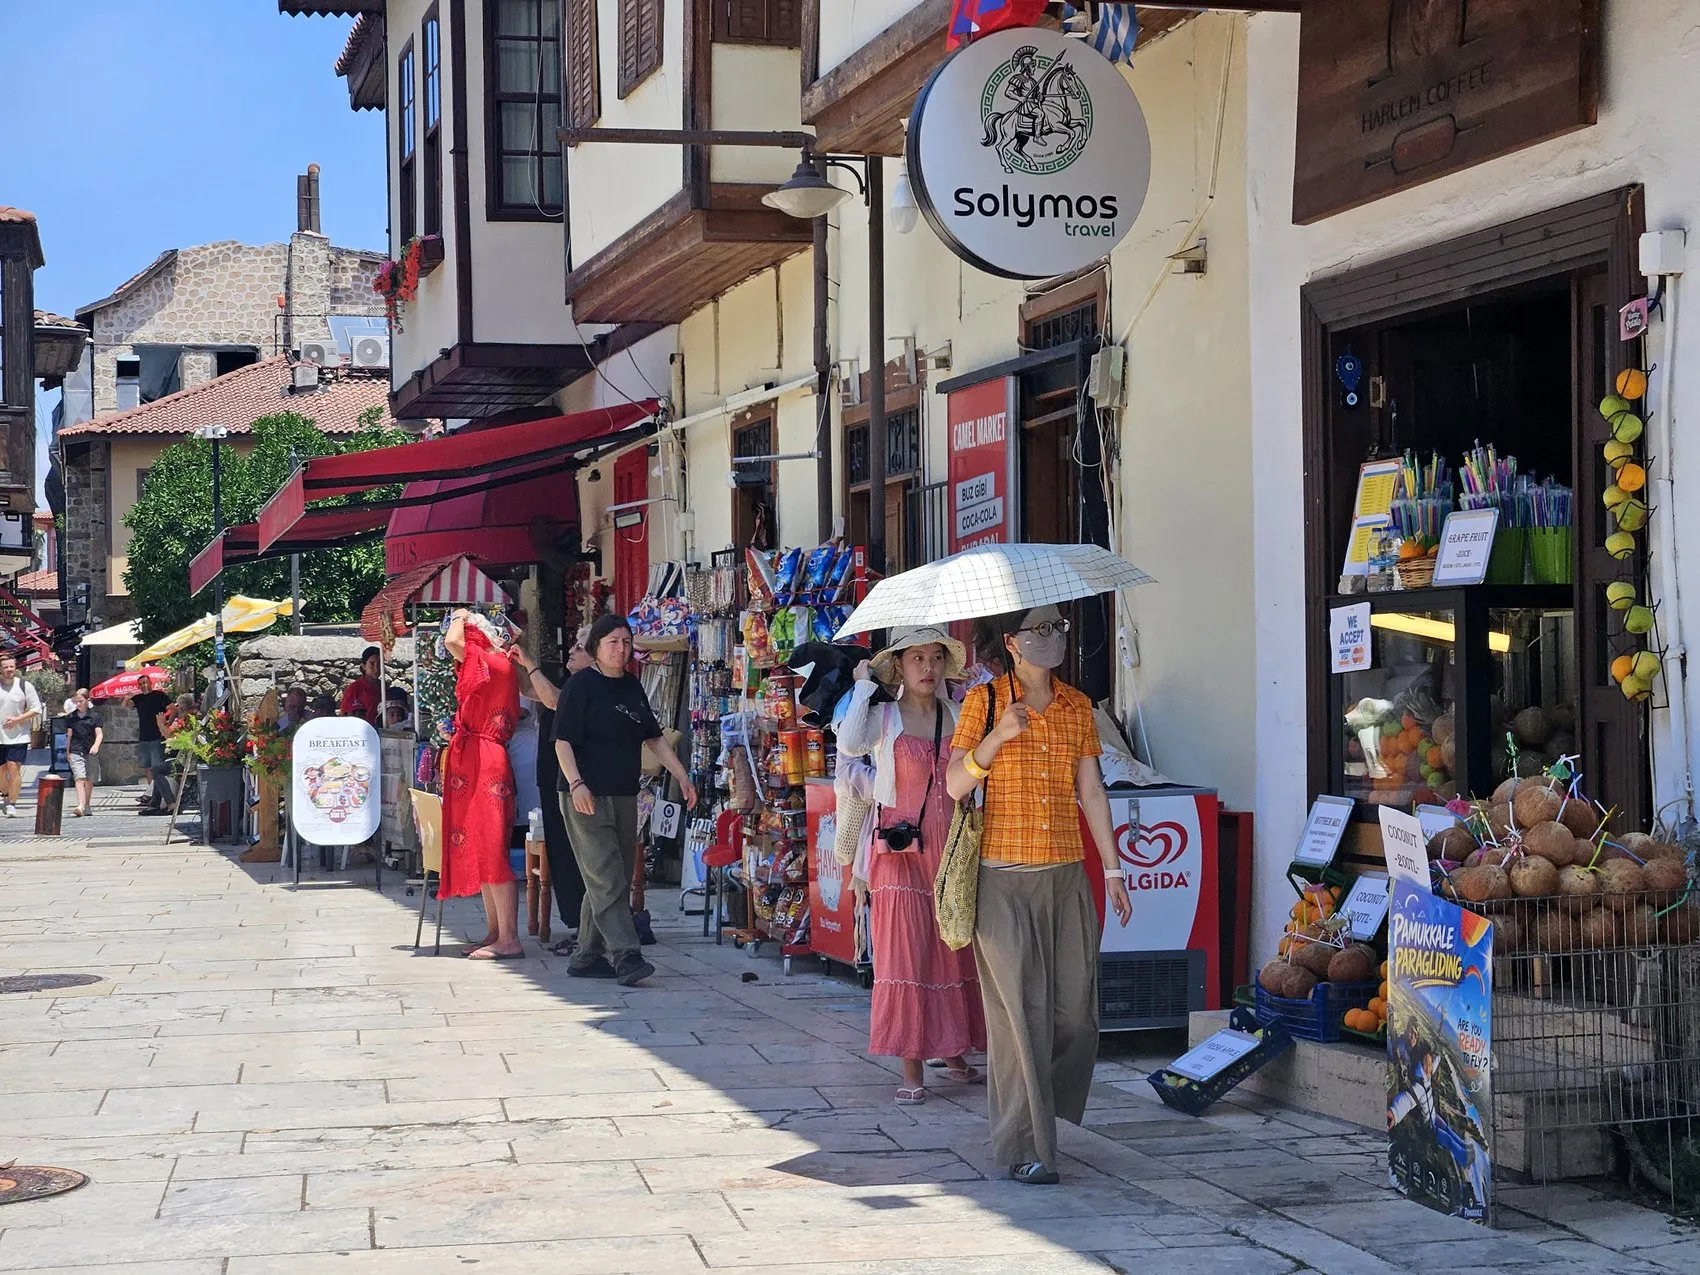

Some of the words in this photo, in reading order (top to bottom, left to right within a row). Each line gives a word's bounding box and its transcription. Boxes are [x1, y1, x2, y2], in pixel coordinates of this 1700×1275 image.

[1361, 95, 1424, 133] HARLEM
[1425, 62, 1492, 108] COFFEE
[954, 184, 1118, 228] Solymos
[1065, 221, 1115, 237] travel
[953, 420, 977, 452] CAMEL
[976, 411, 1007, 447] MARKET
[961, 486, 974, 502] BUZ
[962, 506, 997, 530] COCA-COLA
[1448, 533, 1469, 543] GRAPE
[1470, 532, 1489, 542] FRUIT
[1347, 615, 1358, 629] WE
[1339, 631, 1365, 645] ACCEPT
[309, 739, 368, 748] BREAKFAST
[1387, 825, 1418, 848] COCONUT
[1356, 891, 1386, 905] COCONUT
[1392, 913, 1455, 951] PAMUKKALE
[1394, 946, 1463, 980] PARAGLIDING
[1457, 1017, 1469, 1031] ARE
[1471, 1023, 1482, 1036] YOU
[1458, 1032, 1486, 1056] READY
[1463, 1052, 1470, 1064] TO
